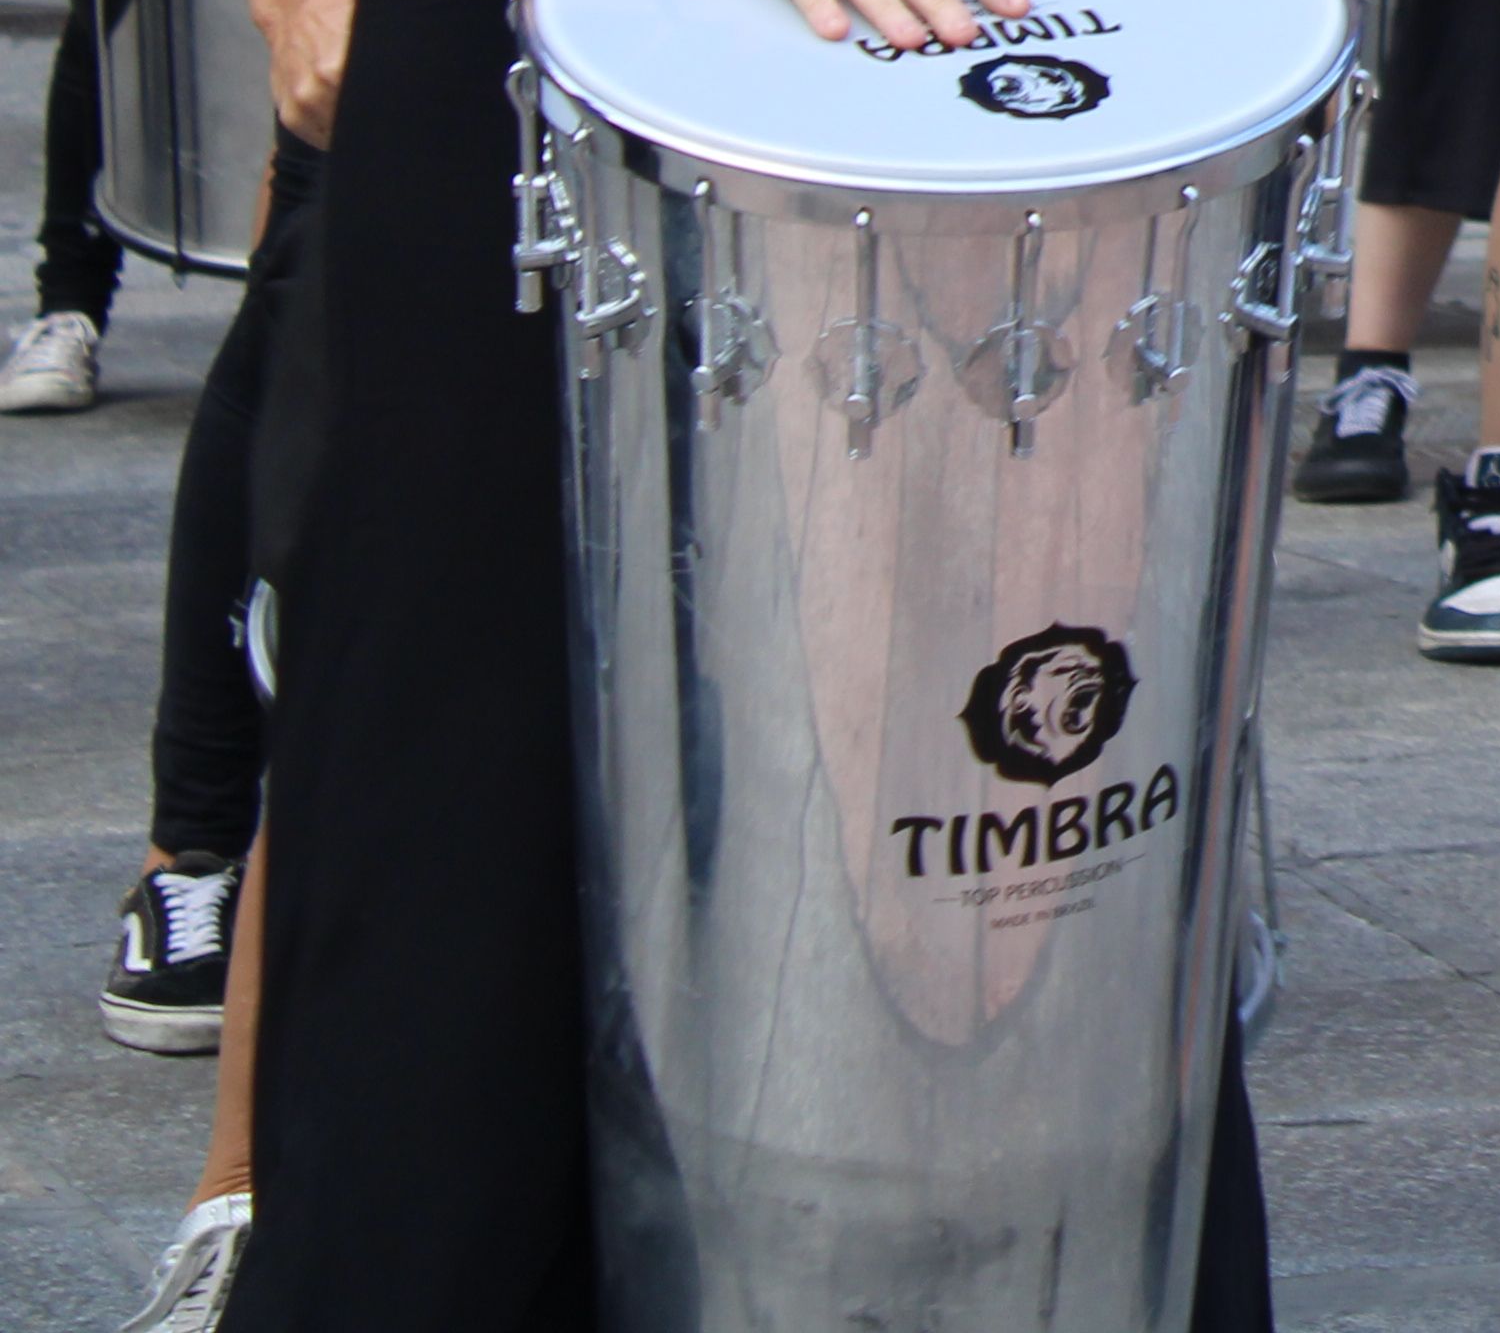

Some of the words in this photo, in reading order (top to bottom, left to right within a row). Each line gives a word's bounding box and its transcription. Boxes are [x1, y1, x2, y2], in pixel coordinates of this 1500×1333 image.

[890, 763, 1179, 877] TIMBRA
[960, 886, 1001, 907] TOP
[1004, 857, 1126, 904] PERCUSSION
